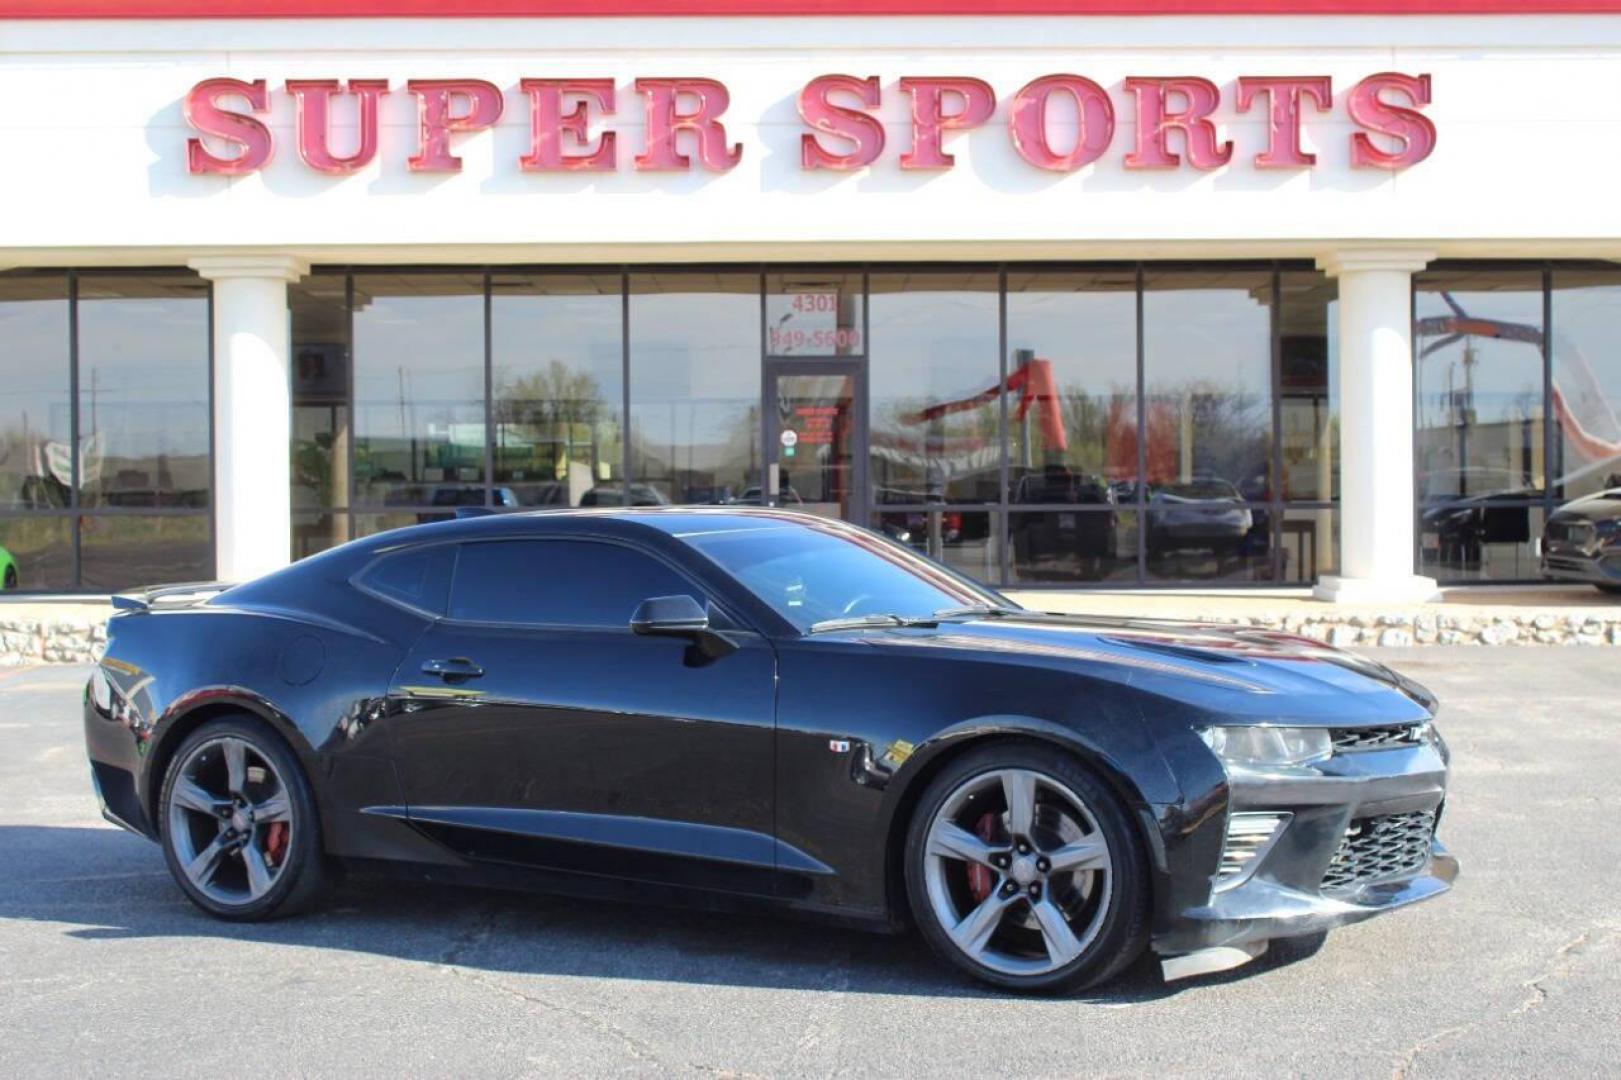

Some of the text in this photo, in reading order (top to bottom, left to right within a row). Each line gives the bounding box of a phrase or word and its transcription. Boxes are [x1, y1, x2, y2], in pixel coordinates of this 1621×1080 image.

[184, 72, 1438, 174] SUPER SPORTS
[792, 293, 838, 312] 4301
